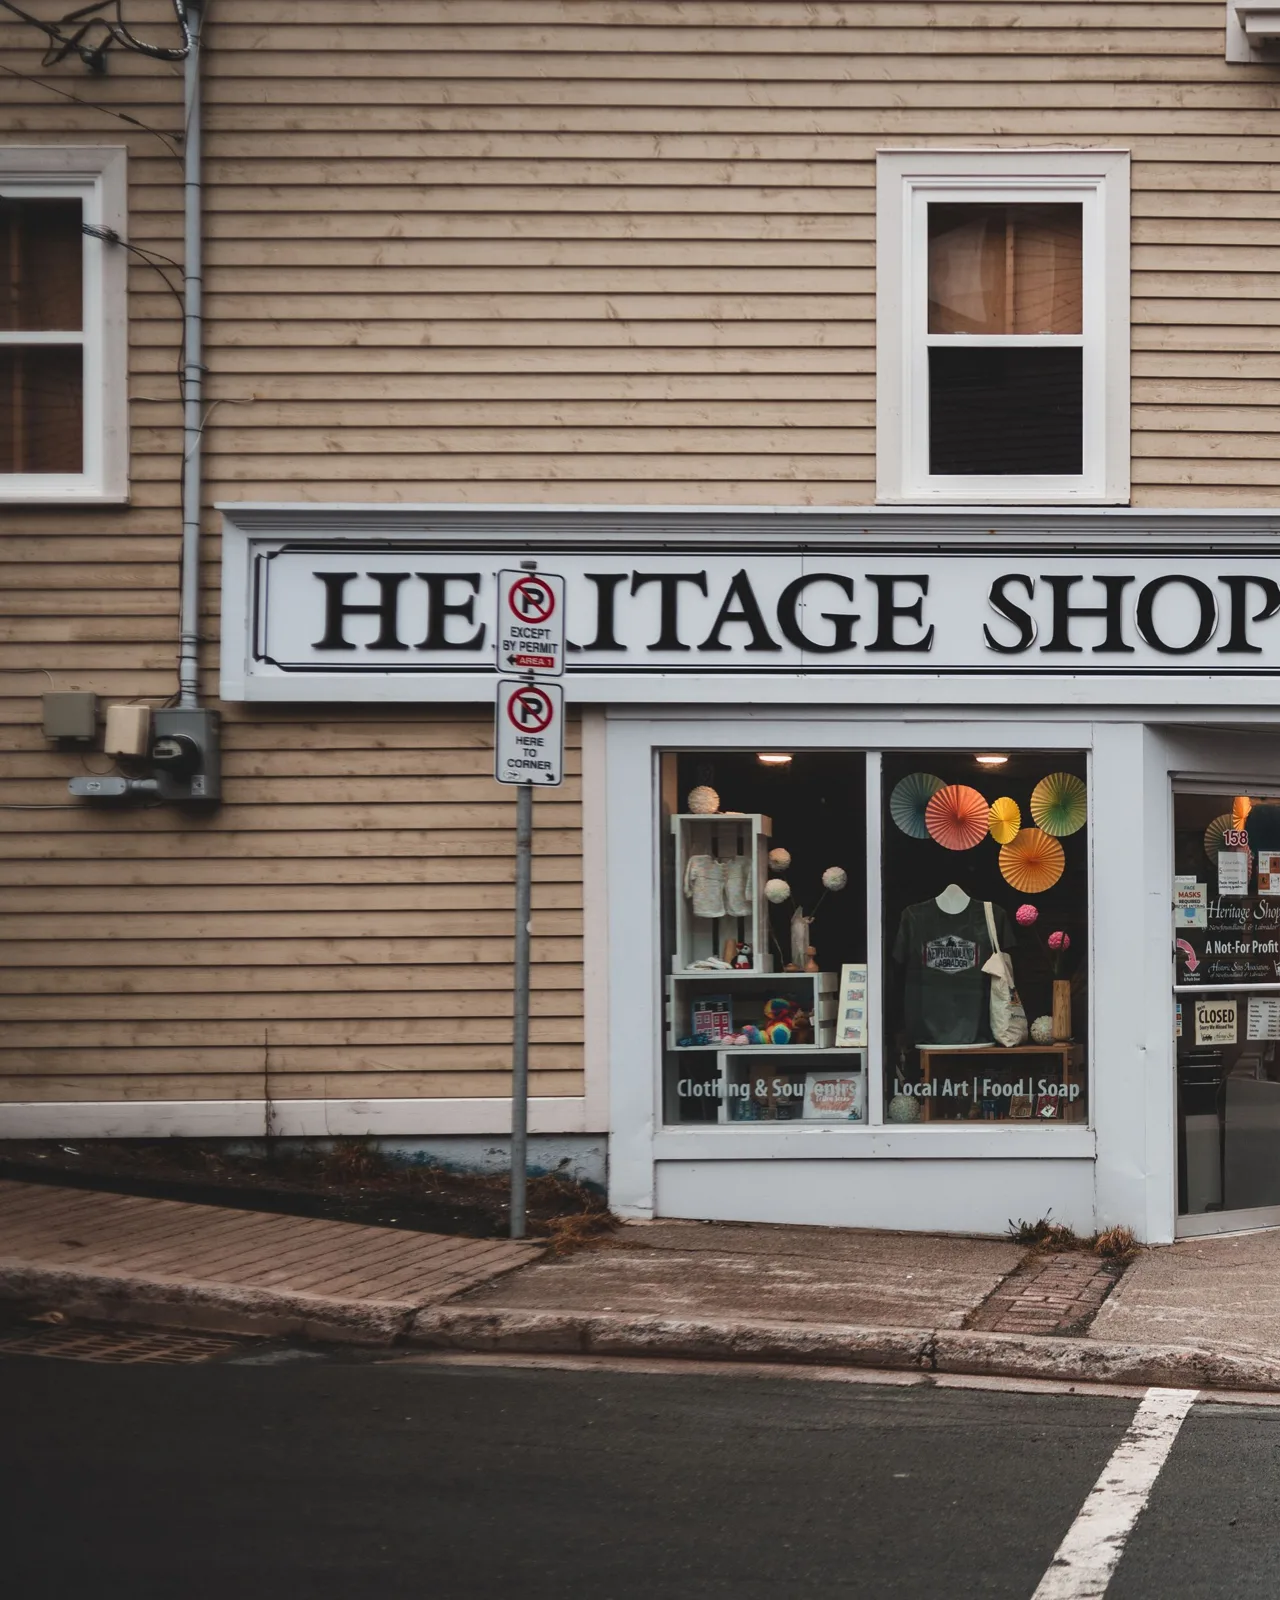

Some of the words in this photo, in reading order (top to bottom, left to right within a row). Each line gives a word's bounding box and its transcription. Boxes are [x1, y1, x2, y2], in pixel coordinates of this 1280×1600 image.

[311, 569, 934, 653] HEITAGE
[510, 626, 551, 640] EXCEPT
[503, 640, 517, 651] BY
[519, 641, 558, 654] PERMIT
[519, 656, 545, 666] AREA
[515, 736, 544, 747] HERE
[523, 748, 537, 758] TO
[507, 758, 552, 770] CORNER
[1224, 830, 1248, 846] 158
[1206, 894, 1250, 924] Heritage
[1206, 941, 1212, 954] A
[1214, 941, 1250, 954] Not-For
[1252, 939, 1278, 954] Profit
[935, 958, 968, 968] LABRADOR
[1199, 1009, 1235, 1024] CLOSED
[677, 1079, 750, 1102] Clothng
[755, 1079, 768, 1097] &
[772, 1079, 856, 1097] Souenirs
[894, 1078, 938, 1097] Local
[941, 1079, 969, 1097] Art
[983, 1078, 1024, 1097] Food
[1037, 1079, 1080, 1102] Soap
